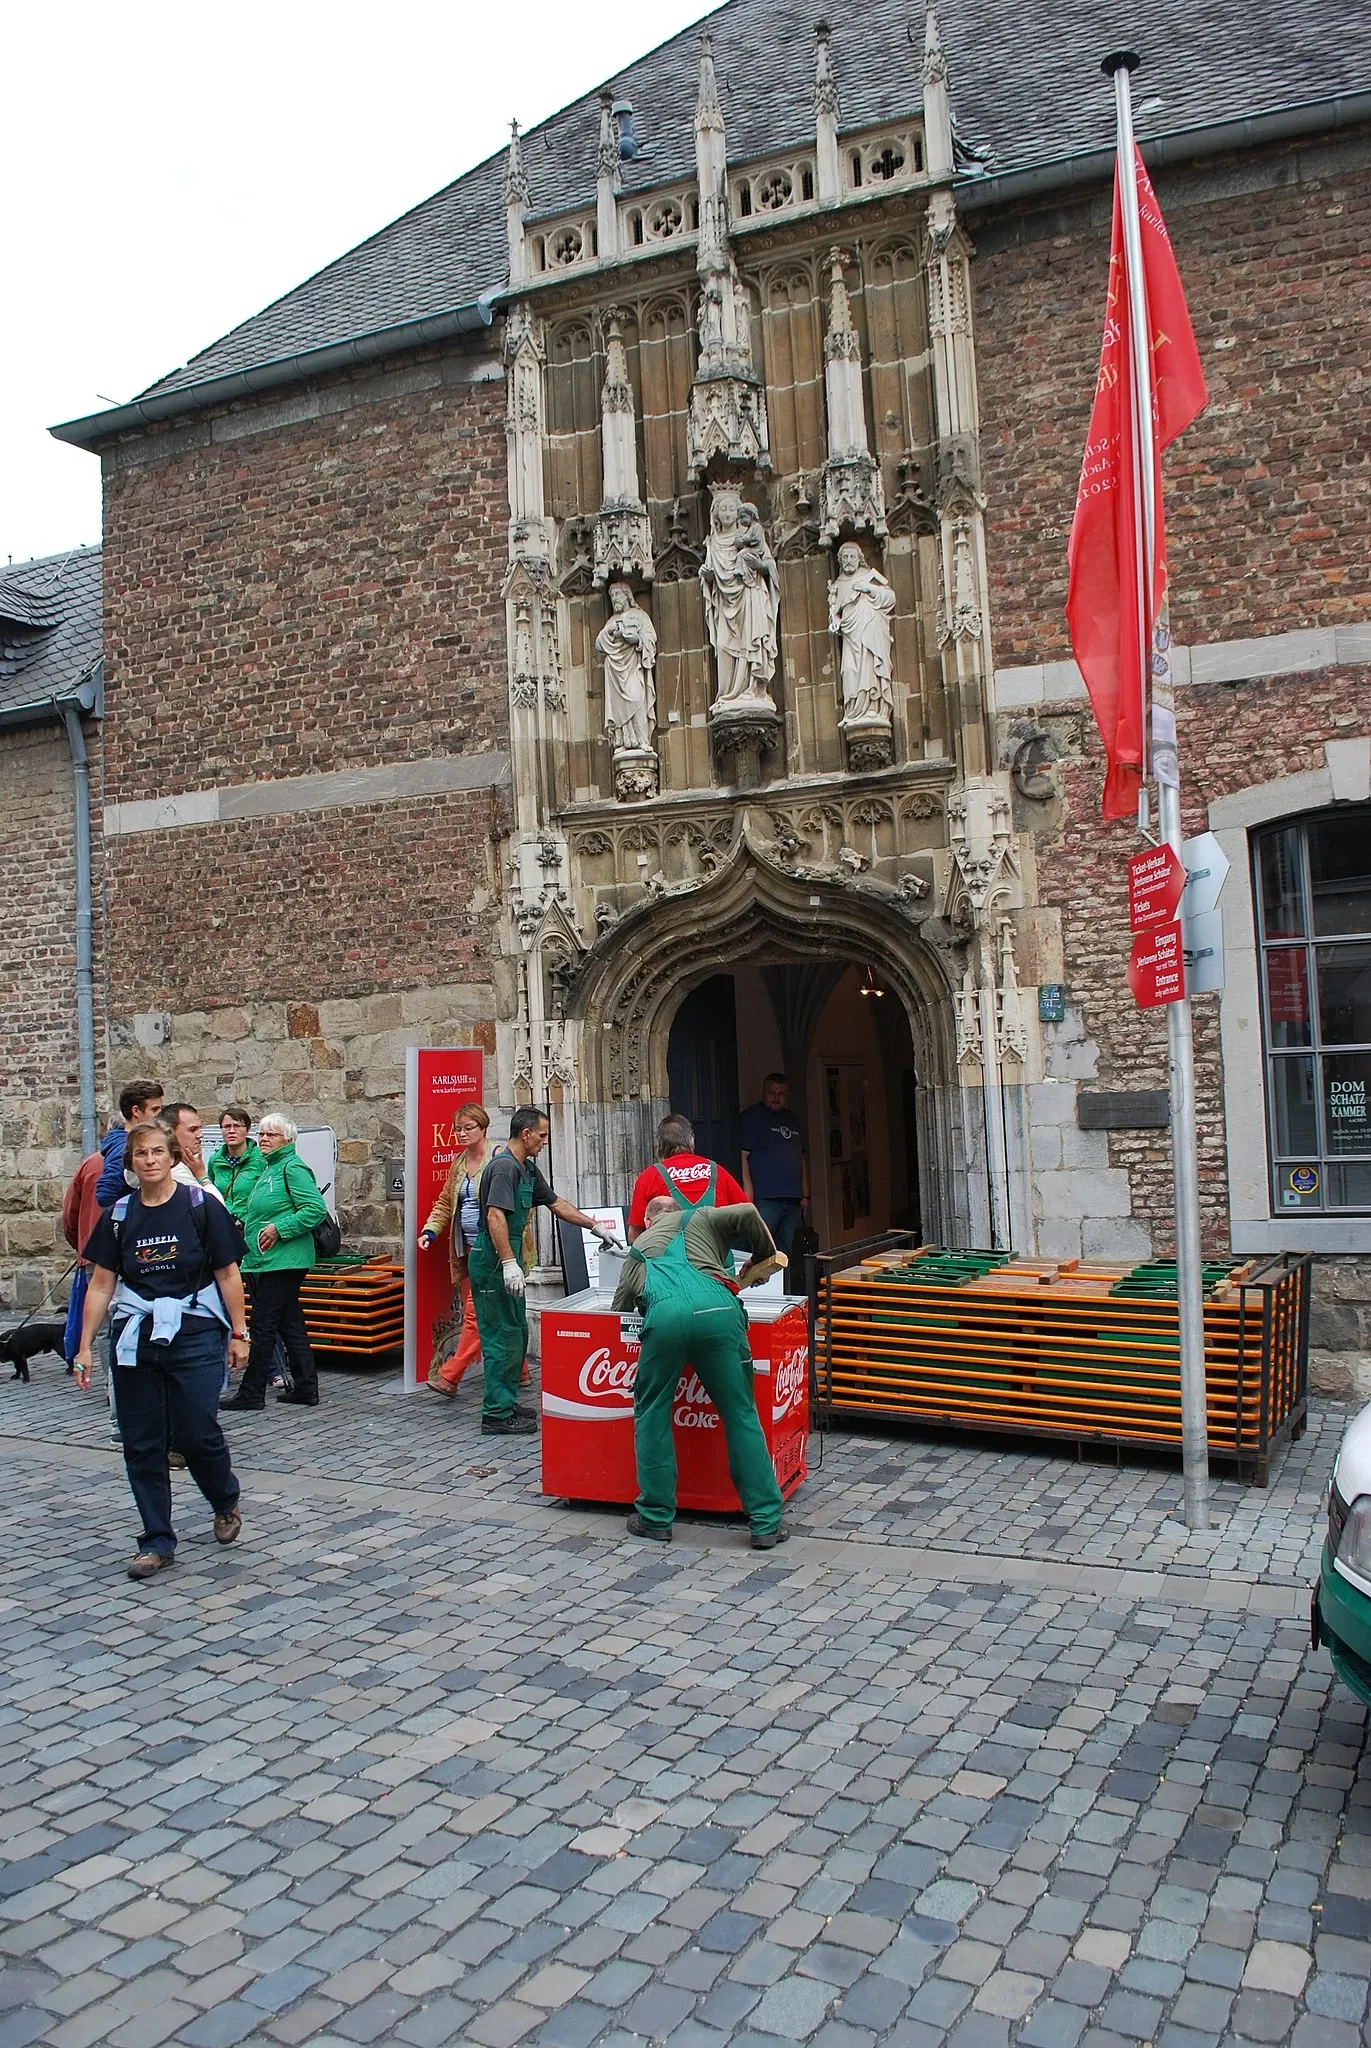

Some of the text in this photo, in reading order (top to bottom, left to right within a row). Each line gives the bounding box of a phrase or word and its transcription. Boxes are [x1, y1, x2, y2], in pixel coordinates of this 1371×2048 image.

[1132, 852, 1166, 876] Ticket-Verkauf
[1133, 901, 1151, 913] Tickets
[1154, 932, 1177, 948] Eingang
[1155, 972, 1179, 987] Entrance
[432, 1075, 468, 1086] KARLSJAHR
[1330, 1080, 1366, 1093] DOM
[1330, 1093, 1367, 1105] SCHATZ
[1331, 1106, 1367, 1118] KAMMER
[432, 1123, 461, 1148] KA
[432, 1149, 461, 1164] charle
[136, 1234, 179, 1247] VENEZIA
[626, 1342, 642, 1354] Trin
[673, 1406, 720, 1429] Coke
